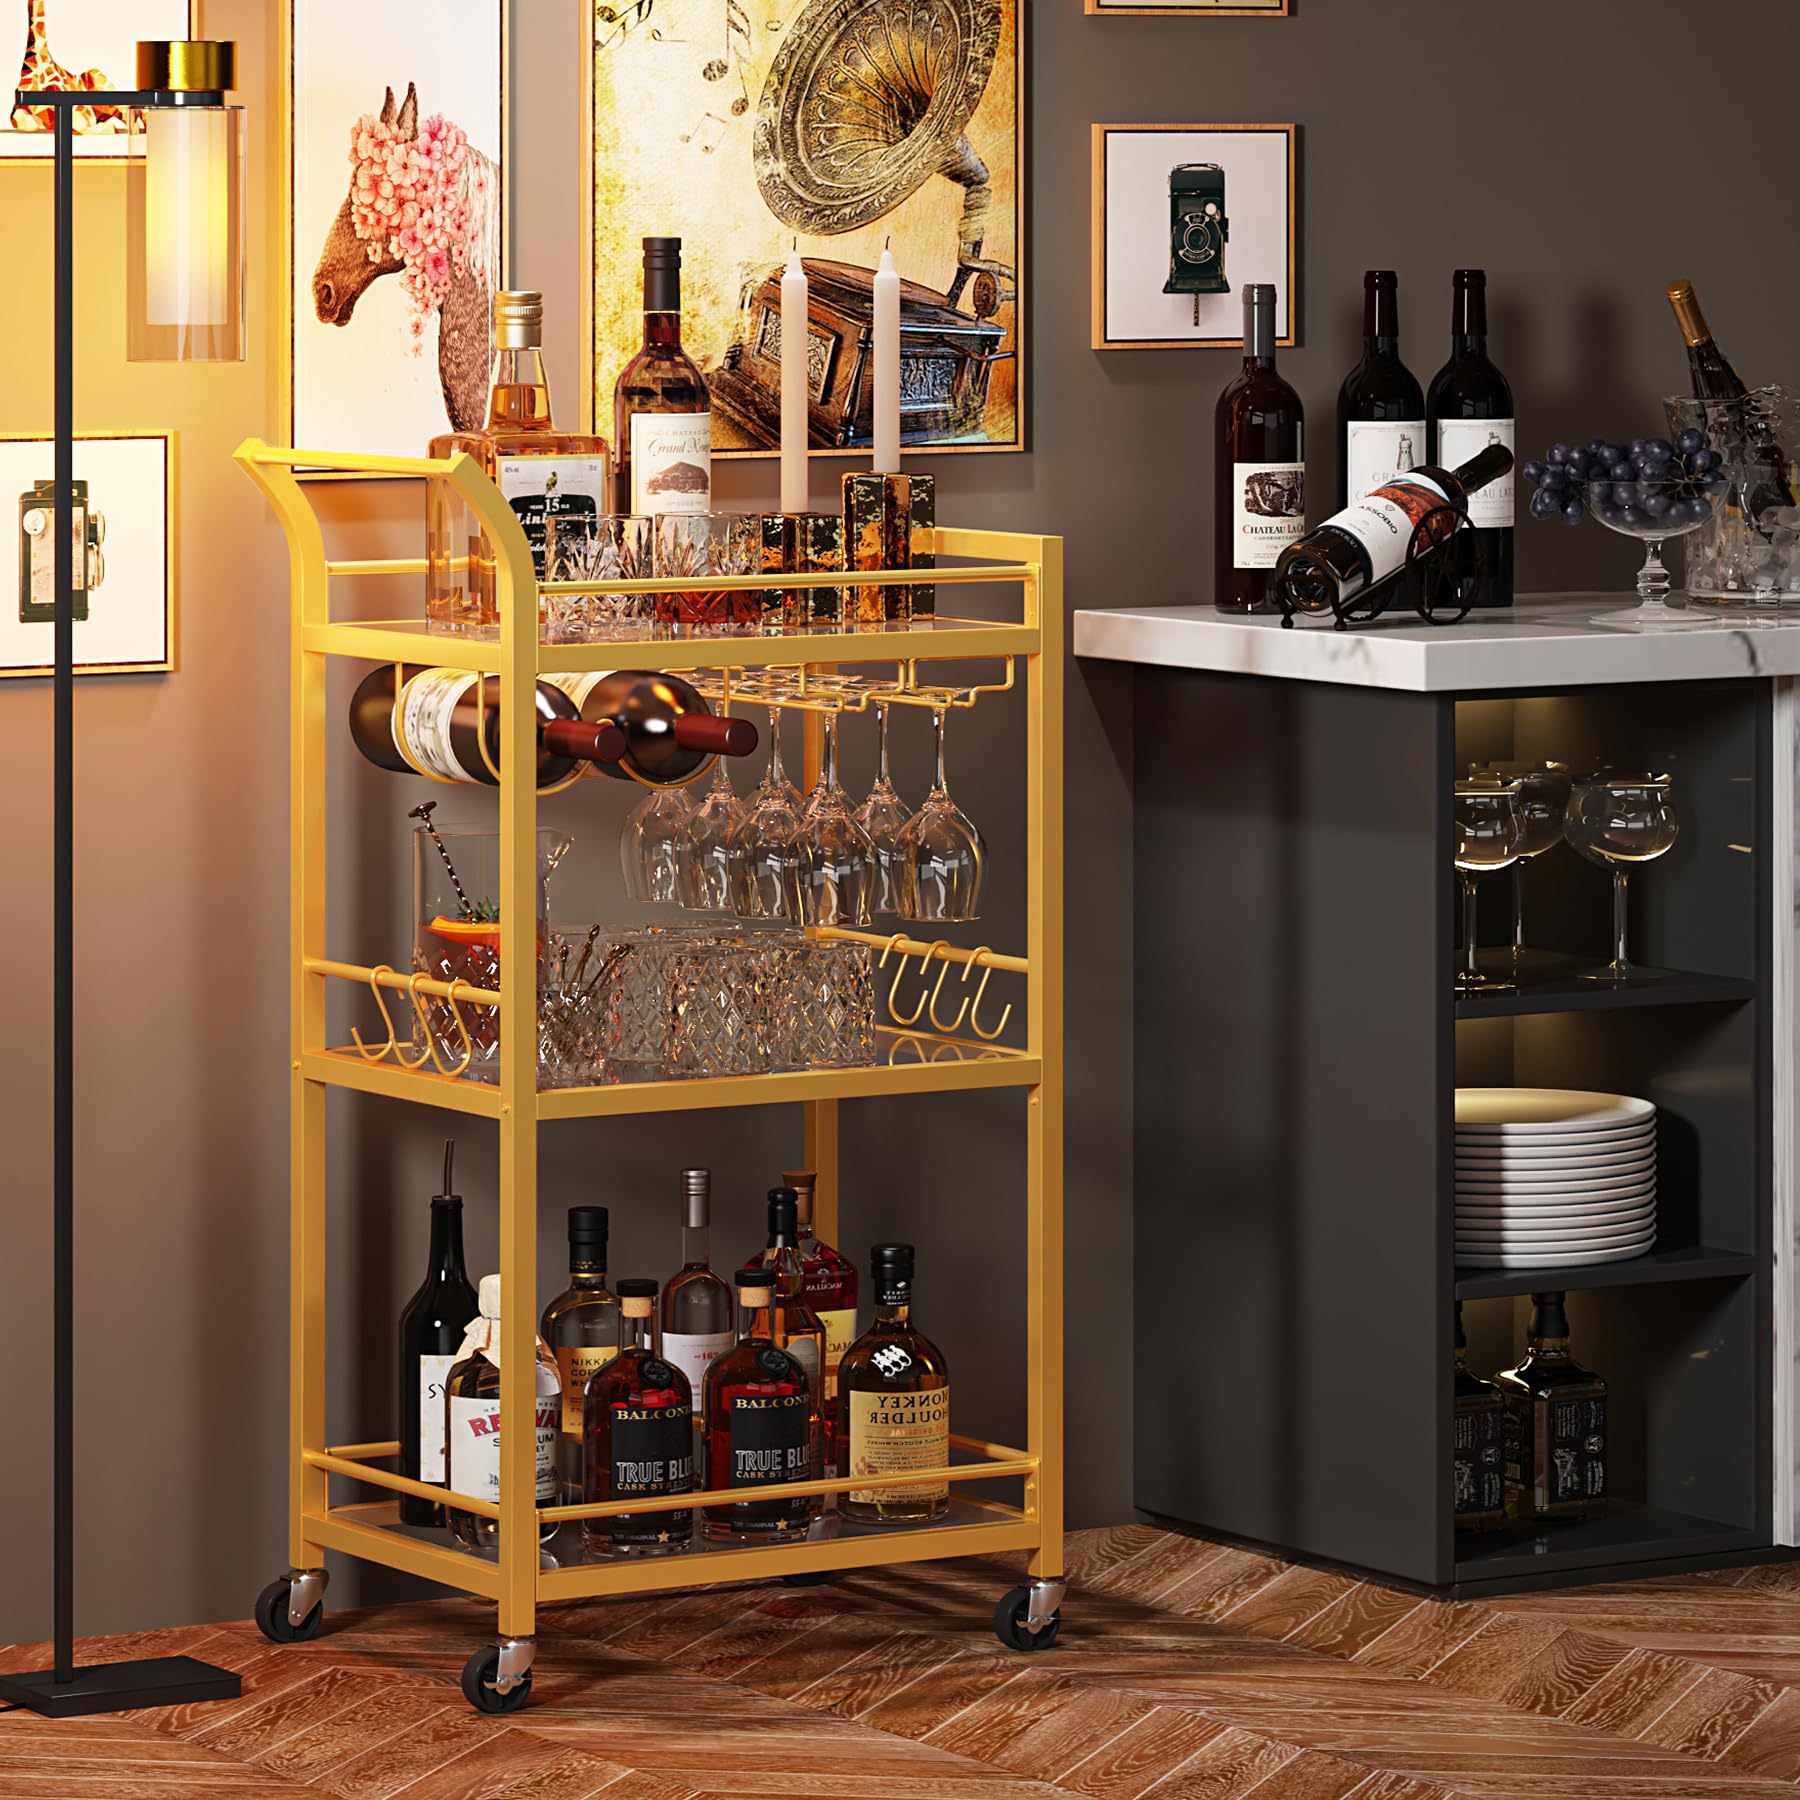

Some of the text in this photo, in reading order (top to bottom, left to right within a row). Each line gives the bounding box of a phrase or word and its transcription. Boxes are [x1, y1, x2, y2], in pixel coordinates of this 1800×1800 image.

[545, 498, 560, 512] 15
[1358, 505, 1398, 534] ASSOBIO
[1242, 524, 1286, 534] CHATEAU
[570, 1358, 608, 1366] NIKKA
[735, 1443, 810, 1471] TRUE BLU
[616, 1461, 664, 1483] TRUE
[617, 1482, 646, 1491] CASK
